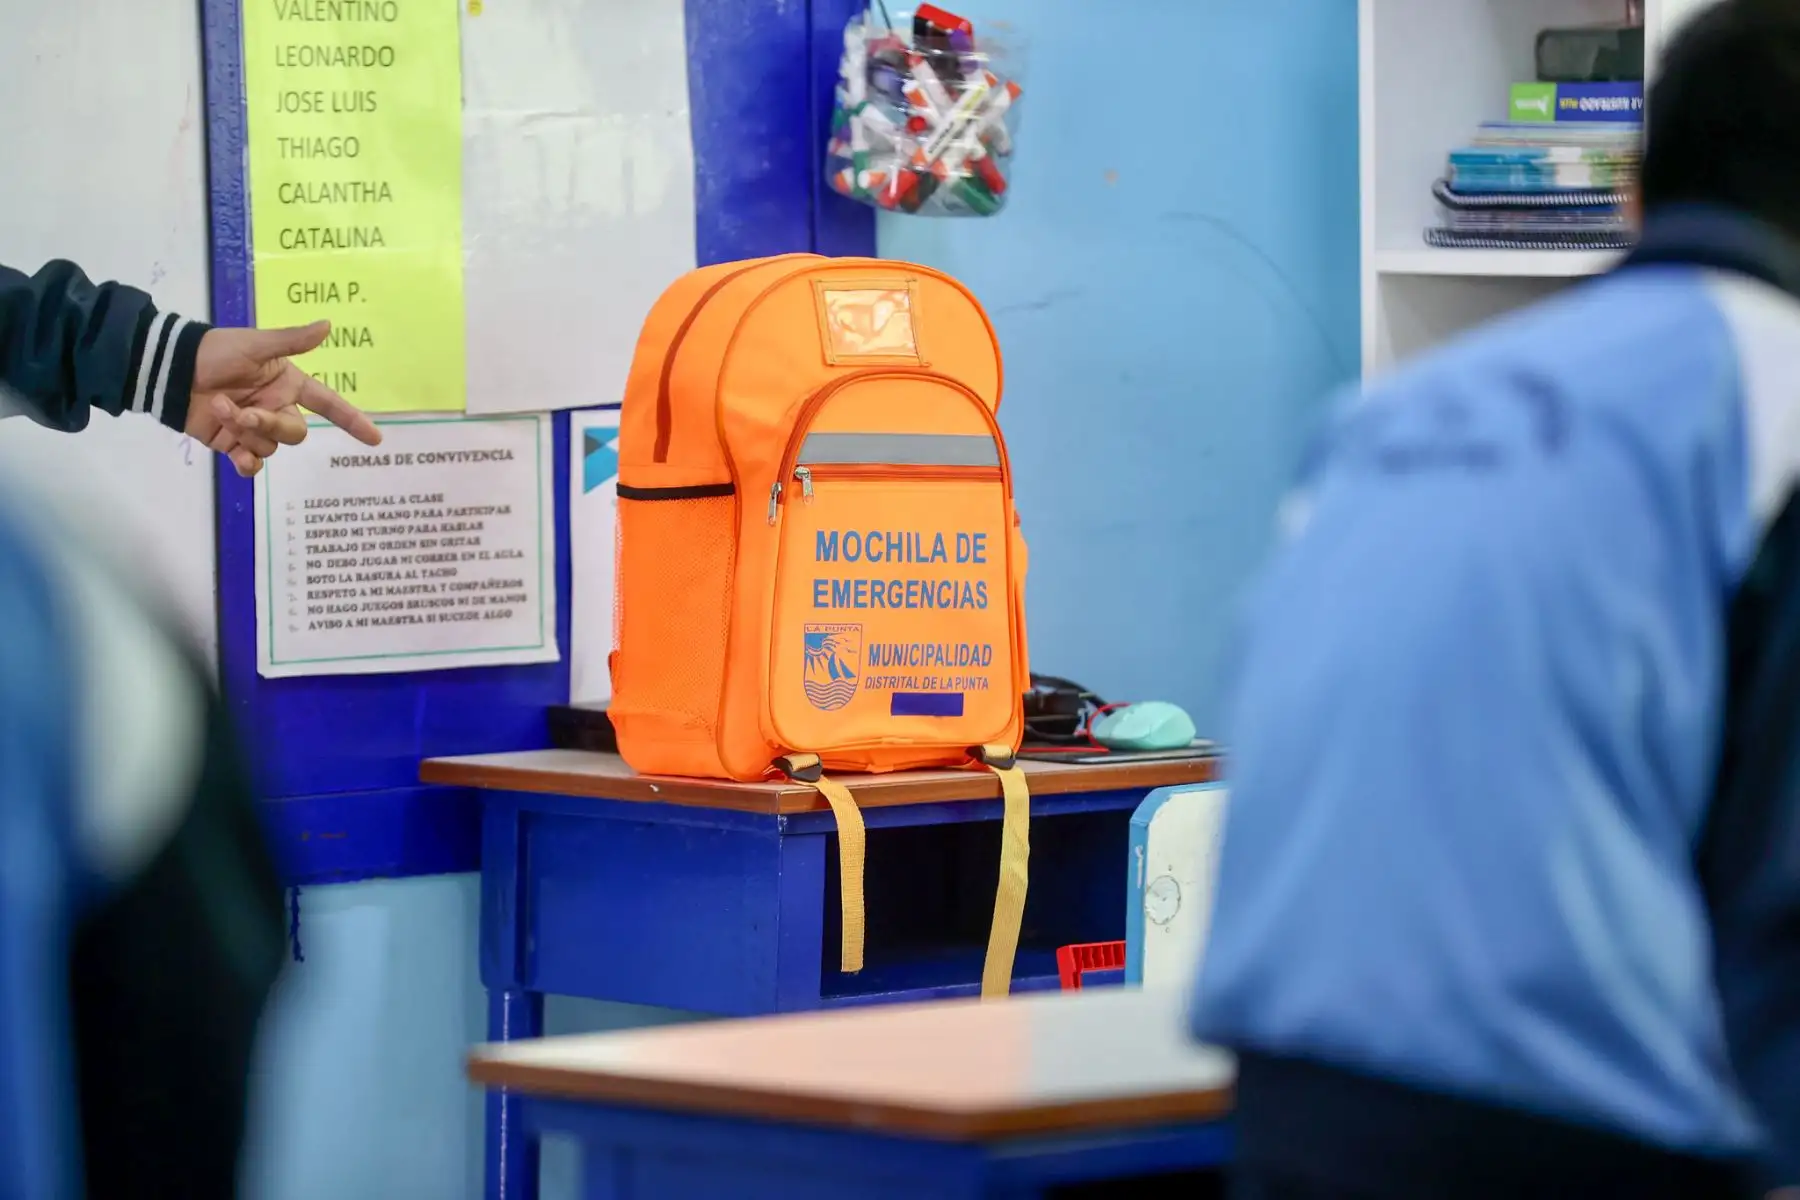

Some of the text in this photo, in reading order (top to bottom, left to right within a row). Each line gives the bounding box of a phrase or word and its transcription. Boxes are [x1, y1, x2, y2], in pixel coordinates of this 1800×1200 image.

[274, 0, 398, 23] VALENTINO
[275, 45, 394, 67] LEONARDO
[276, 91, 376, 113] JOSE LUIS
[278, 137, 360, 158] THIAGO
[278, 182, 393, 204] CALANTHA
[280, 227, 384, 250] CATALINA
[287, 281, 366, 303] GHIA P.
[320, 327, 374, 348] NNA
[311, 372, 357, 392] LIN
[330, 449, 514, 469] NORMAS DE CONVIVENCIA
[304, 497, 339, 509] LLEGO
[342, 496, 395, 507] PUNTUAL
[399, 495, 407, 506] A
[409, 494, 444, 504] CLASE
[305, 513, 358, 524] LEVANTO
[361, 512, 374, 522] LA
[377, 510, 410, 521] MANO
[414, 508, 444, 519] PARA
[446, 505, 511, 517] PARTICIPAR
[305, 528, 348, 539] ESPERO
[350, 527, 364, 537] MI
[367, 525, 405, 536] TURNO
[408, 524, 438, 534] PARA
[305, 543, 358, 554] TRABAJO
[361, 542, 375, 552] EN
[378, 540, 416, 551] ORDEN
[419, 539, 437, 549] SIN
[440, 537, 480, 548] GRITAR
[816, 531, 987, 563] MOCHILA DE
[327, 558, 357, 569] DEBO
[360, 556, 397, 568] JUGAR
[401, 555, 413, 565] NI
[461, 552, 476, 562] EN
[479, 551, 491, 561] EL
[307, 574, 336, 585] BOTO
[339, 573, 353, 583] LA
[355, 571, 403, 582] BASURA
[406, 570, 420, 580] AL
[422, 568, 457, 578] TACHO
[307, 589, 357, 601] RESPETO
[360, 588, 368, 598] A
[370, 587, 384, 597] MI
[387, 585, 437, 596] MAESTRA
[449, 579, 523, 593] COMPAÑEROS
[813, 579, 987, 609] EMERGENCIAS
[326, 603, 357, 614] HAGO
[360, 601, 404, 613] JUEGOS
[407, 599, 455, 610] BRUSCOS
[458, 597, 469, 608] NI
[472, 596, 486, 606] DE
[308, 620, 343, 631] AVISO
[346, 619, 354, 629] A
[356, 618, 369, 628] MI
[371, 615, 423, 626] MAESTRA
[427, 614, 436, 625] SI
[438, 612, 480, 623] SUCEDE
[482, 609, 513, 620] ALGO
[868, 644, 992, 667] MUNICIPALIDAD
[865, 677, 988, 690] DISTRITAL DE LA PUNTA
